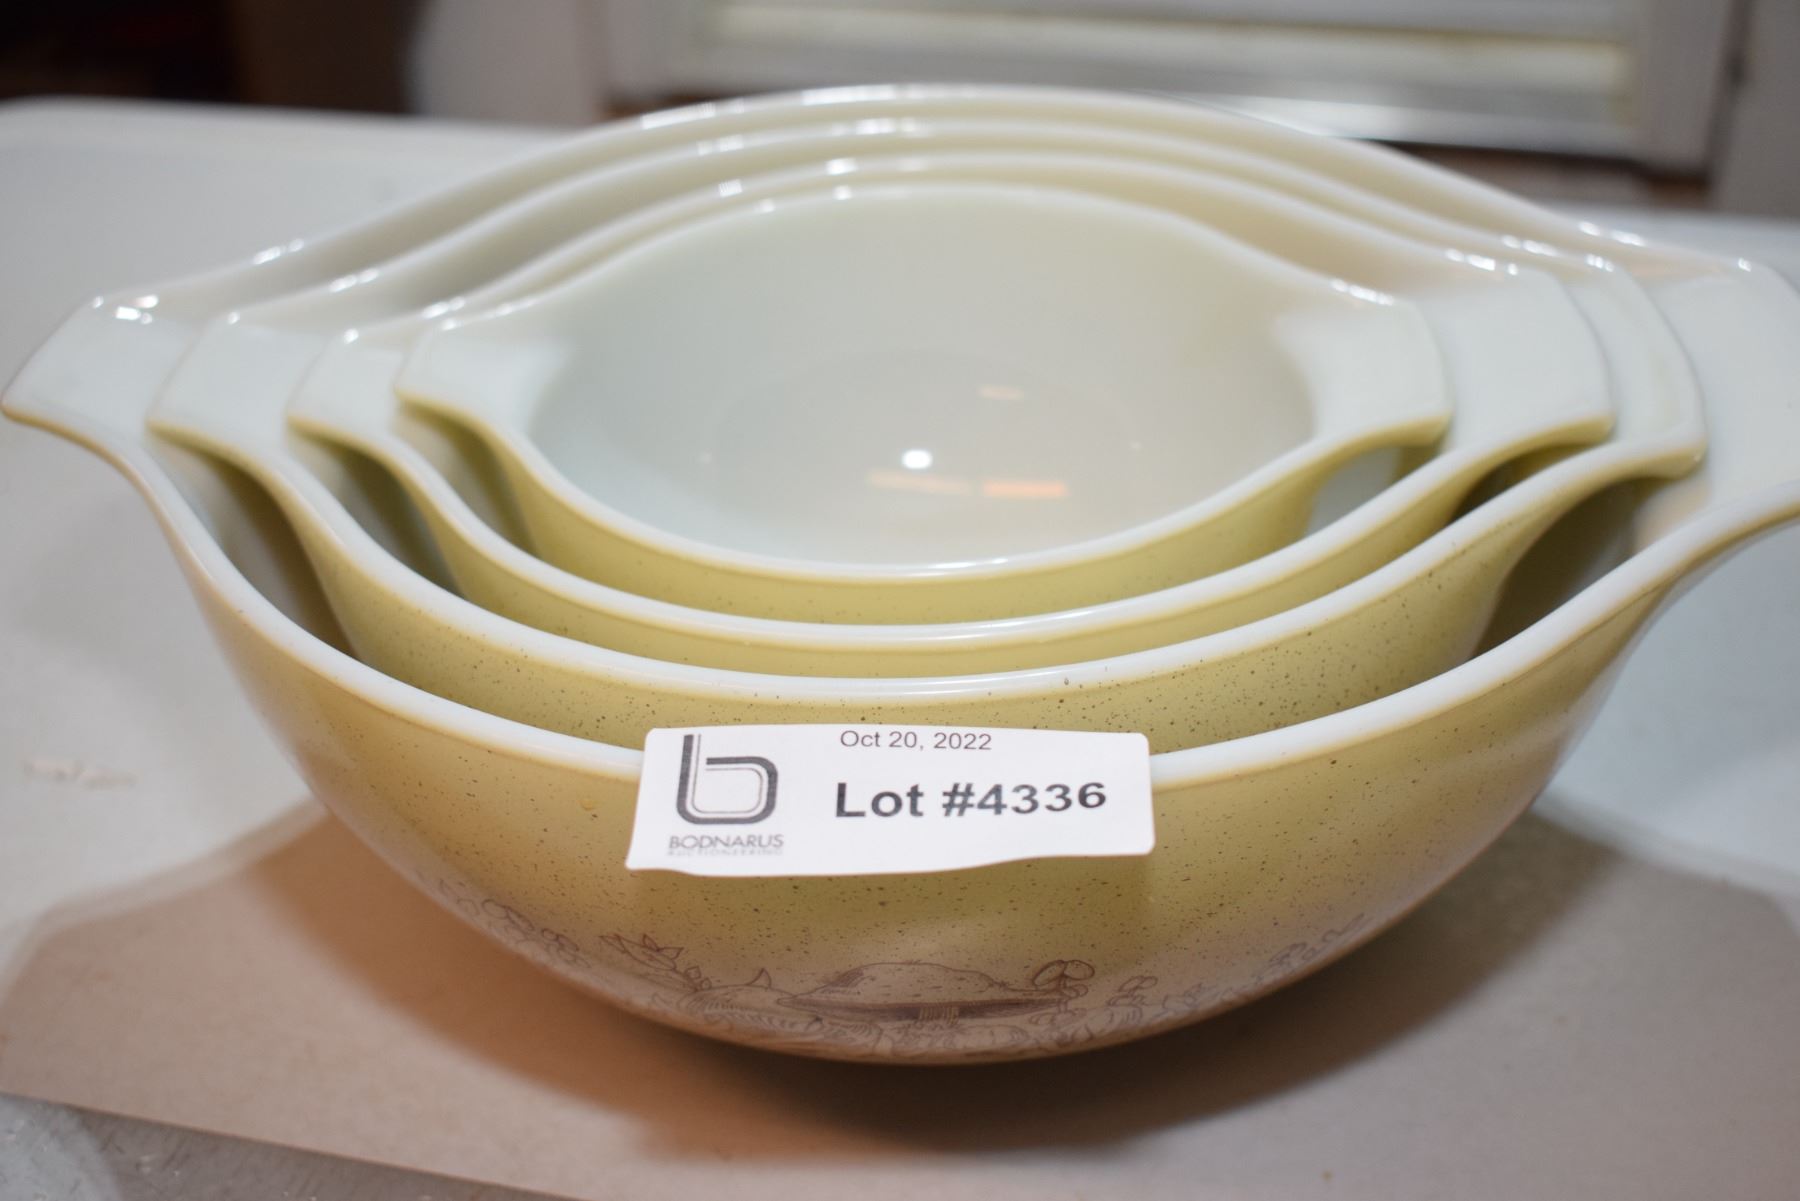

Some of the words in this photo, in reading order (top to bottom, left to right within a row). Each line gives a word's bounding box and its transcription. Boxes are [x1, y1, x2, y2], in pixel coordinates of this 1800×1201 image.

[840, 730, 880, 747] Oct
[888, 731, 924, 751] 20,
[933, 732, 992, 750] 2022
[835, 782, 924, 817] Lot
[942, 782, 1107, 817] #4336
[669, 834, 785, 849] BODNARUS
